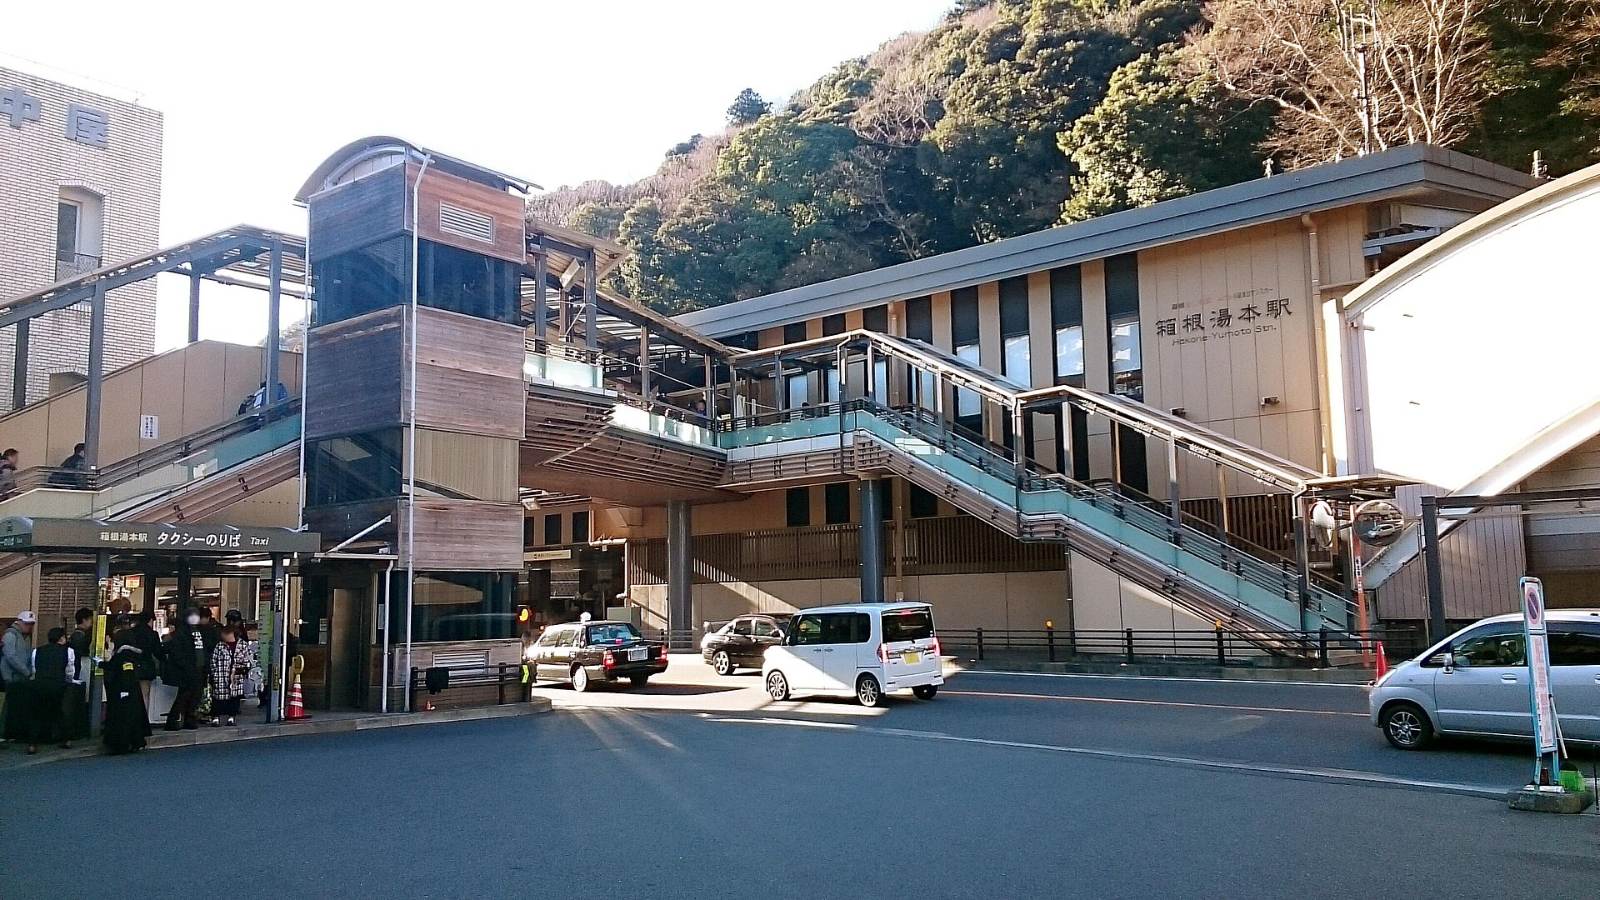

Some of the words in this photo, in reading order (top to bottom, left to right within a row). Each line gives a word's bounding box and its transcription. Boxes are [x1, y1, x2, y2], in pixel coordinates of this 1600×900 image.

[1155, 297, 1293, 337] 箱根湯本駅
[99, 531, 148, 542] 箱根湯本駅
[157, 531, 241, 548] タクシーのりば
[251, 536, 269, 546] Taxi
